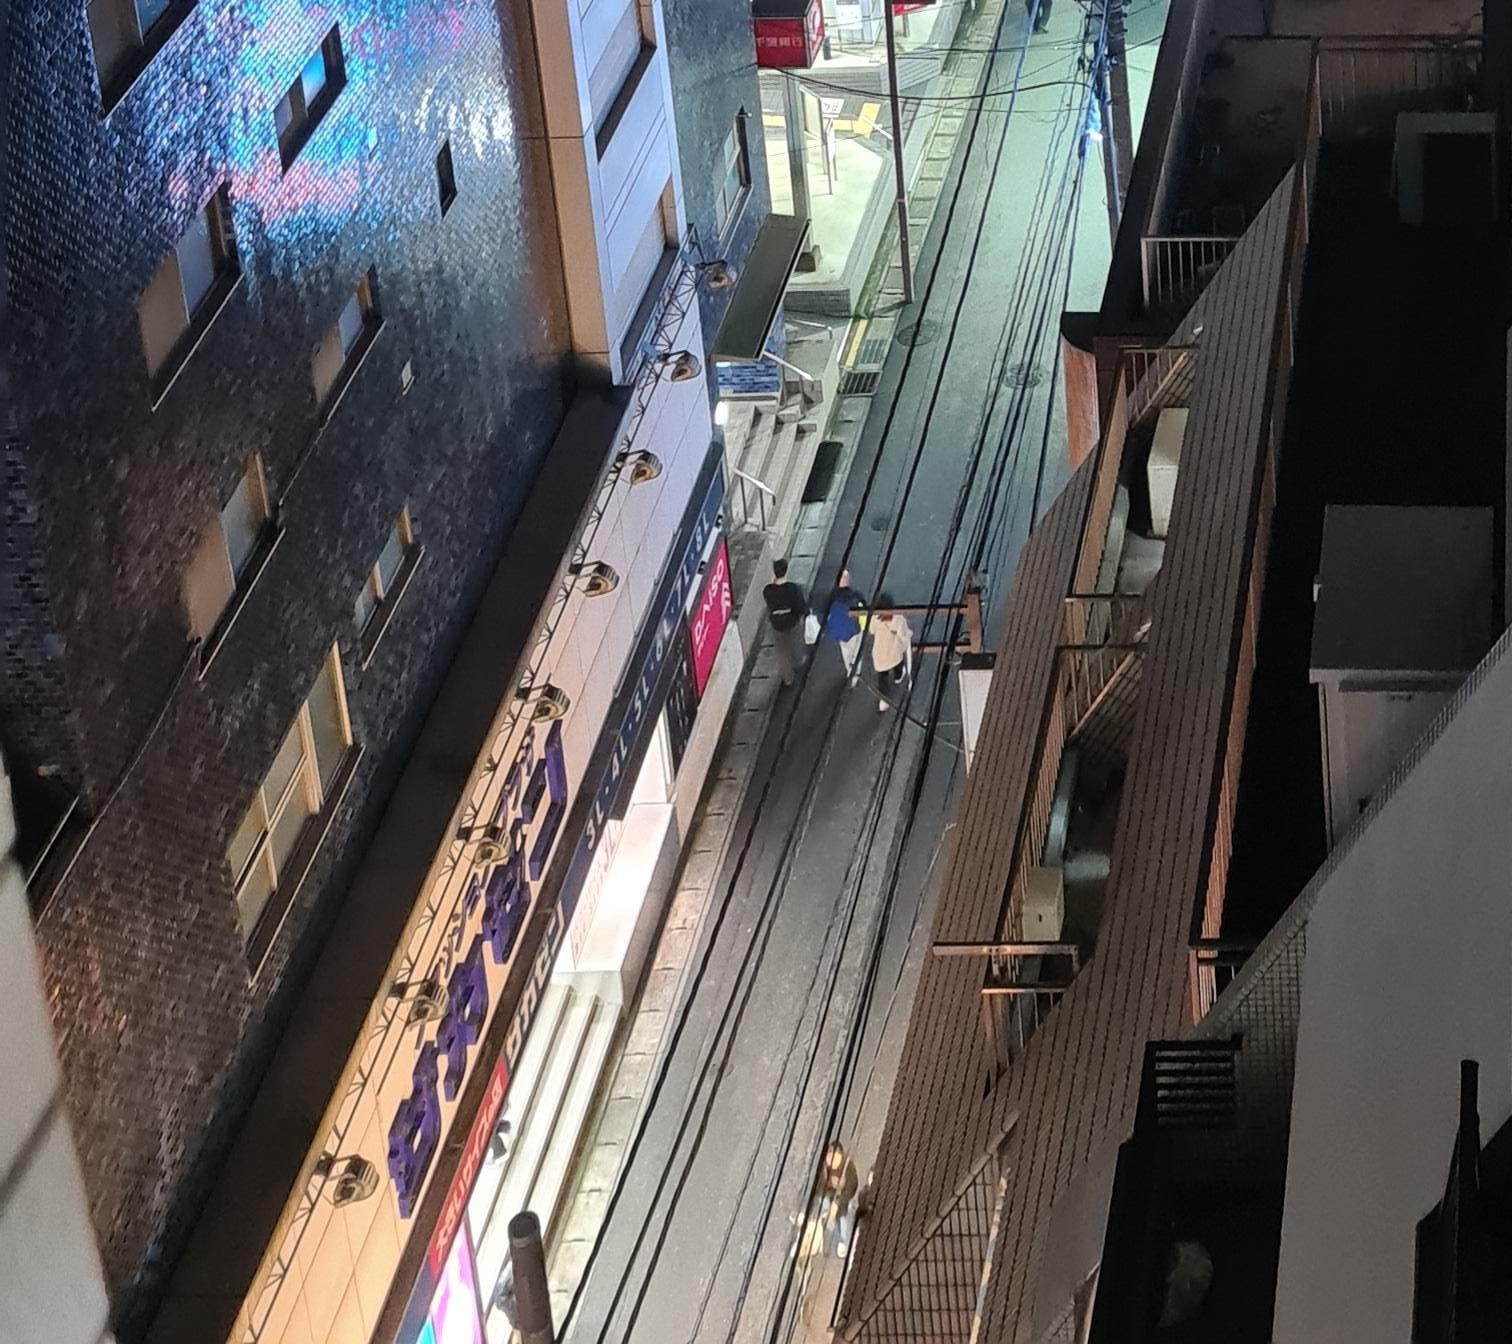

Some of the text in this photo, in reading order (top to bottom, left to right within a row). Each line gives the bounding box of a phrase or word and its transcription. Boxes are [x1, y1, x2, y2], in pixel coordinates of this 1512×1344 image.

[694, 558, 724, 643] DAISO
[505, 901, 565, 1061] サカゼン
